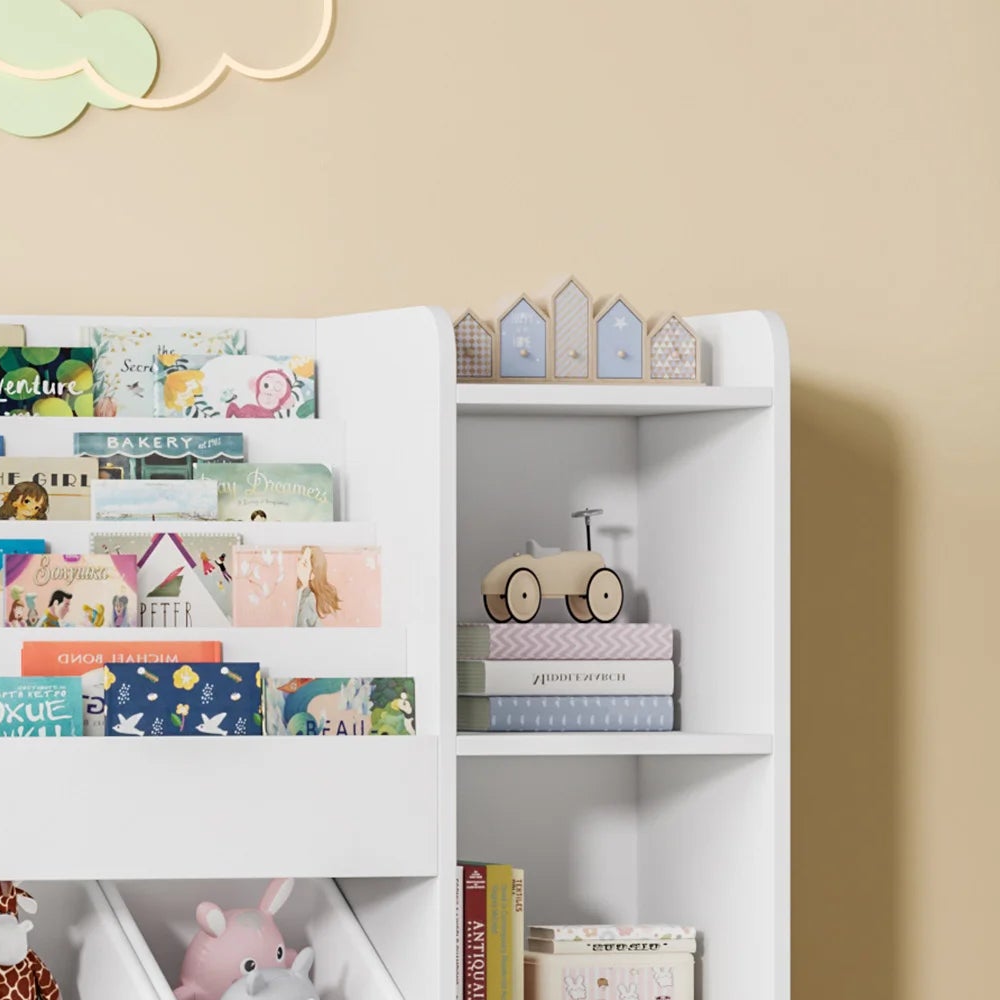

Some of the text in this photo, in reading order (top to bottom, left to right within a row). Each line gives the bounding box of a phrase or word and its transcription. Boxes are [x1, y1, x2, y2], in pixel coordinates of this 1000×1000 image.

[107, 437, 193, 449] BAKERY
[32, 472, 91, 487] GIRL
[140, 602, 193, 627] PETER
